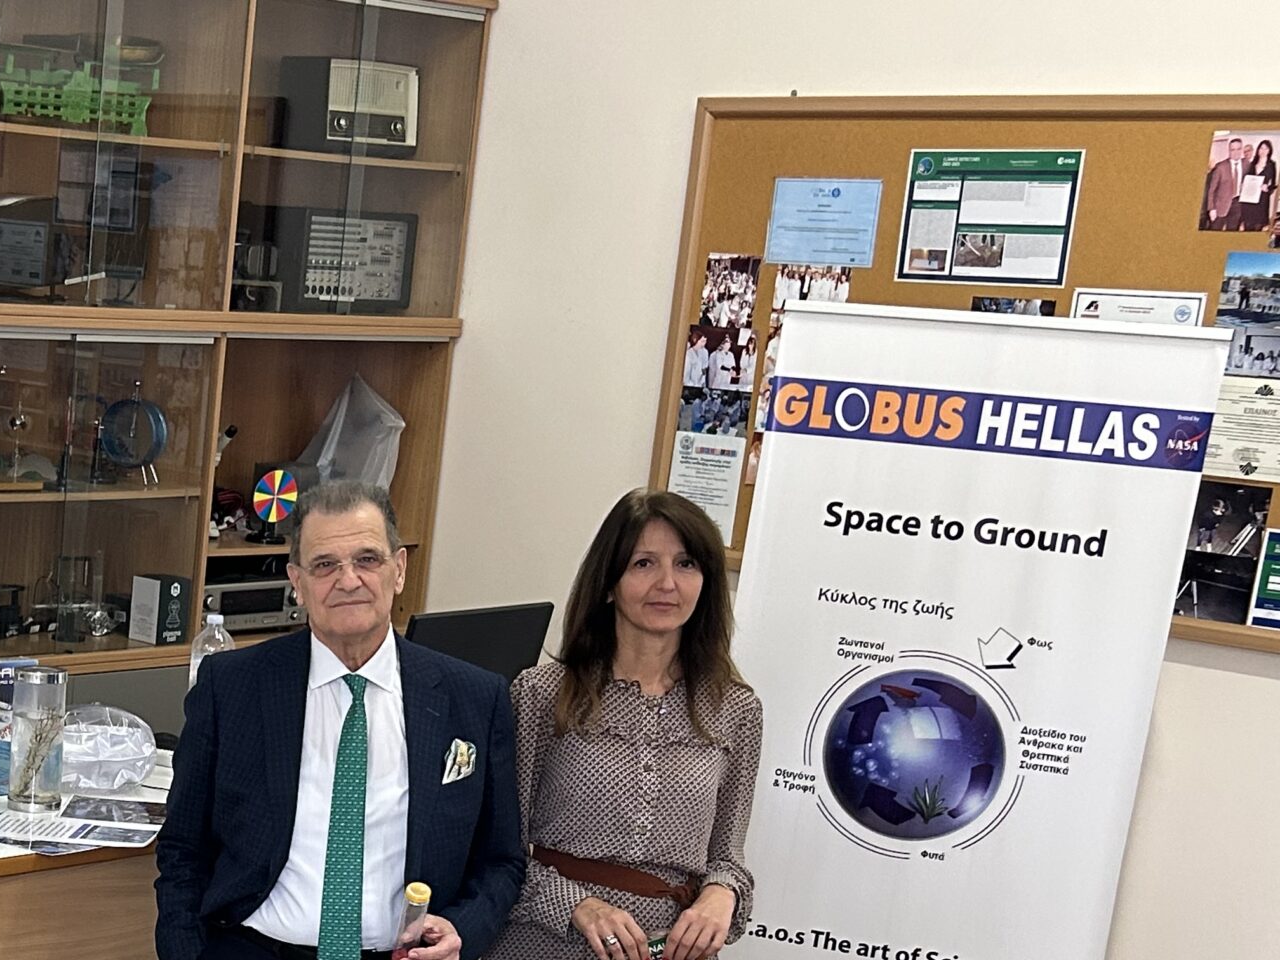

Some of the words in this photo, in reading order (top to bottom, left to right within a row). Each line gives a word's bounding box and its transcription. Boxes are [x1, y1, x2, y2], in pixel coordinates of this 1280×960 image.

[773, 383, 967, 441] GLOBUS
[976, 398, 1160, 461] HELLAS
[1166, 438, 1199, 452] NASA
[823, 501, 921, 536] Space
[930, 514, 965, 541] to
[973, 517, 1108, 558] Ground
[818, 588, 877, 610] Κύκλος
[881, 598, 908, 614] της
[913, 599, 955, 620] ζωής
[838, 636, 885, 650] Ζωντανοί
[1027, 637, 1053, 651] Φως
[837, 648, 894, 663] Οργανισμοί
[1020, 725, 1066, 740] Διοξείδιο
[1069, 733, 1086, 742] του
[1066, 744, 1083, 753] και
[775, 768, 816, 782] Οξυγόνο
[772, 779, 780, 787] &
[783, 780, 816, 795] Τροφή
[920, 850, 945, 861] Φυτά
[746, 917, 806, 945] .a.o.s
[810, 929, 851, 953] The
[856, 942, 890, 960] art
